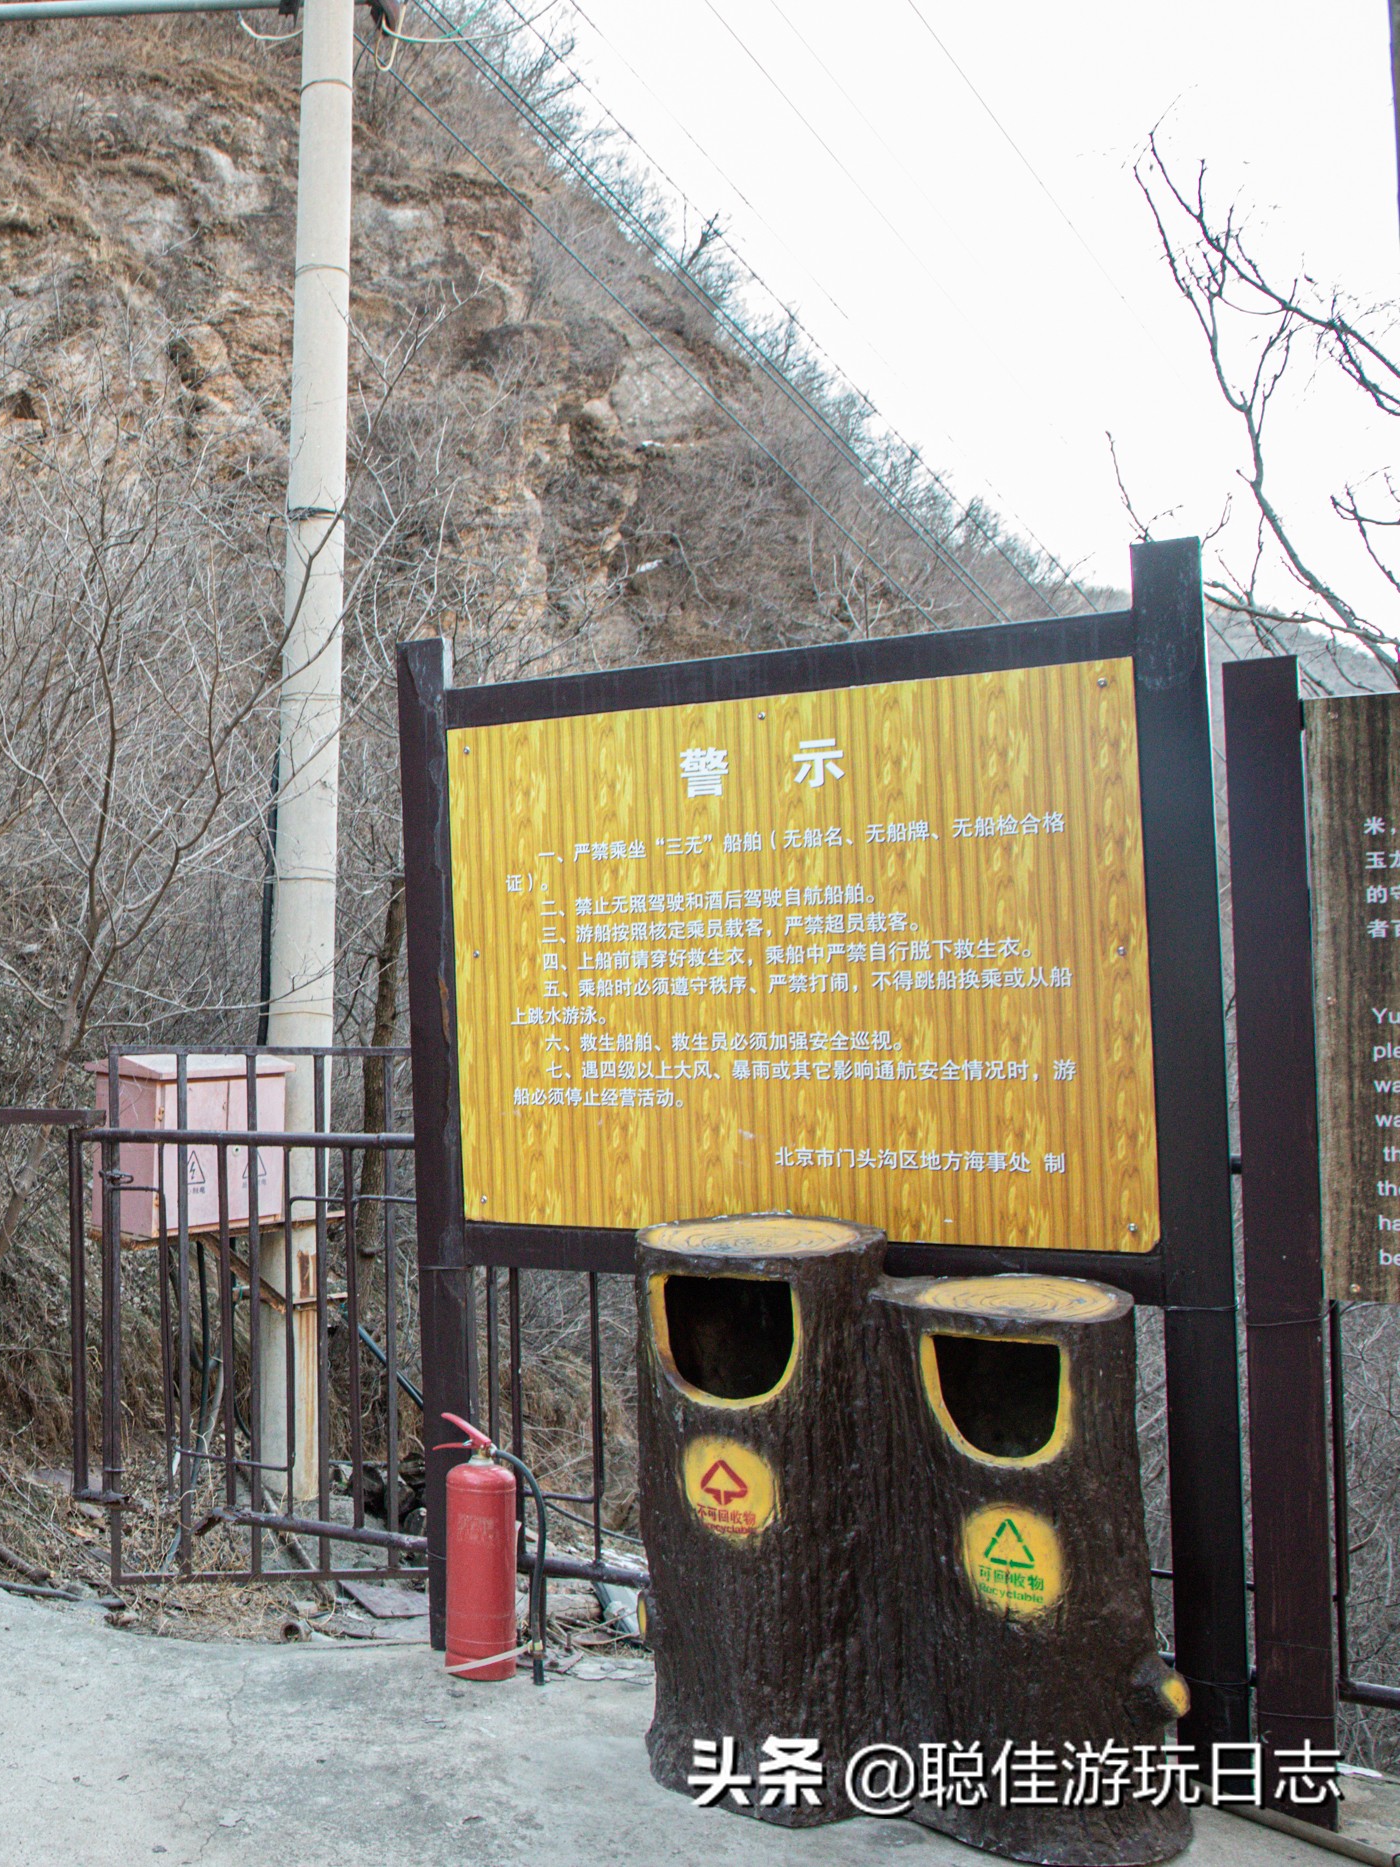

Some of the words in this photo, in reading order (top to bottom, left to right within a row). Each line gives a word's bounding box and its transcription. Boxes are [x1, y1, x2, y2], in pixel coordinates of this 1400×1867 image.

[510, 1005, 608, 1027] 上跳水游泳。
[513, 1086, 686, 1109] 船必须停止经营活动。
[775, 1146, 1030, 1174] 北京市门头沟区地方海事处
[1044, 1152, 1066, 1174] 制
[697, 1504, 756, 1526] 不可回收物
[979, 1565, 1044, 1591] 可回收物
[979, 1583, 1044, 1604] Recyclable
